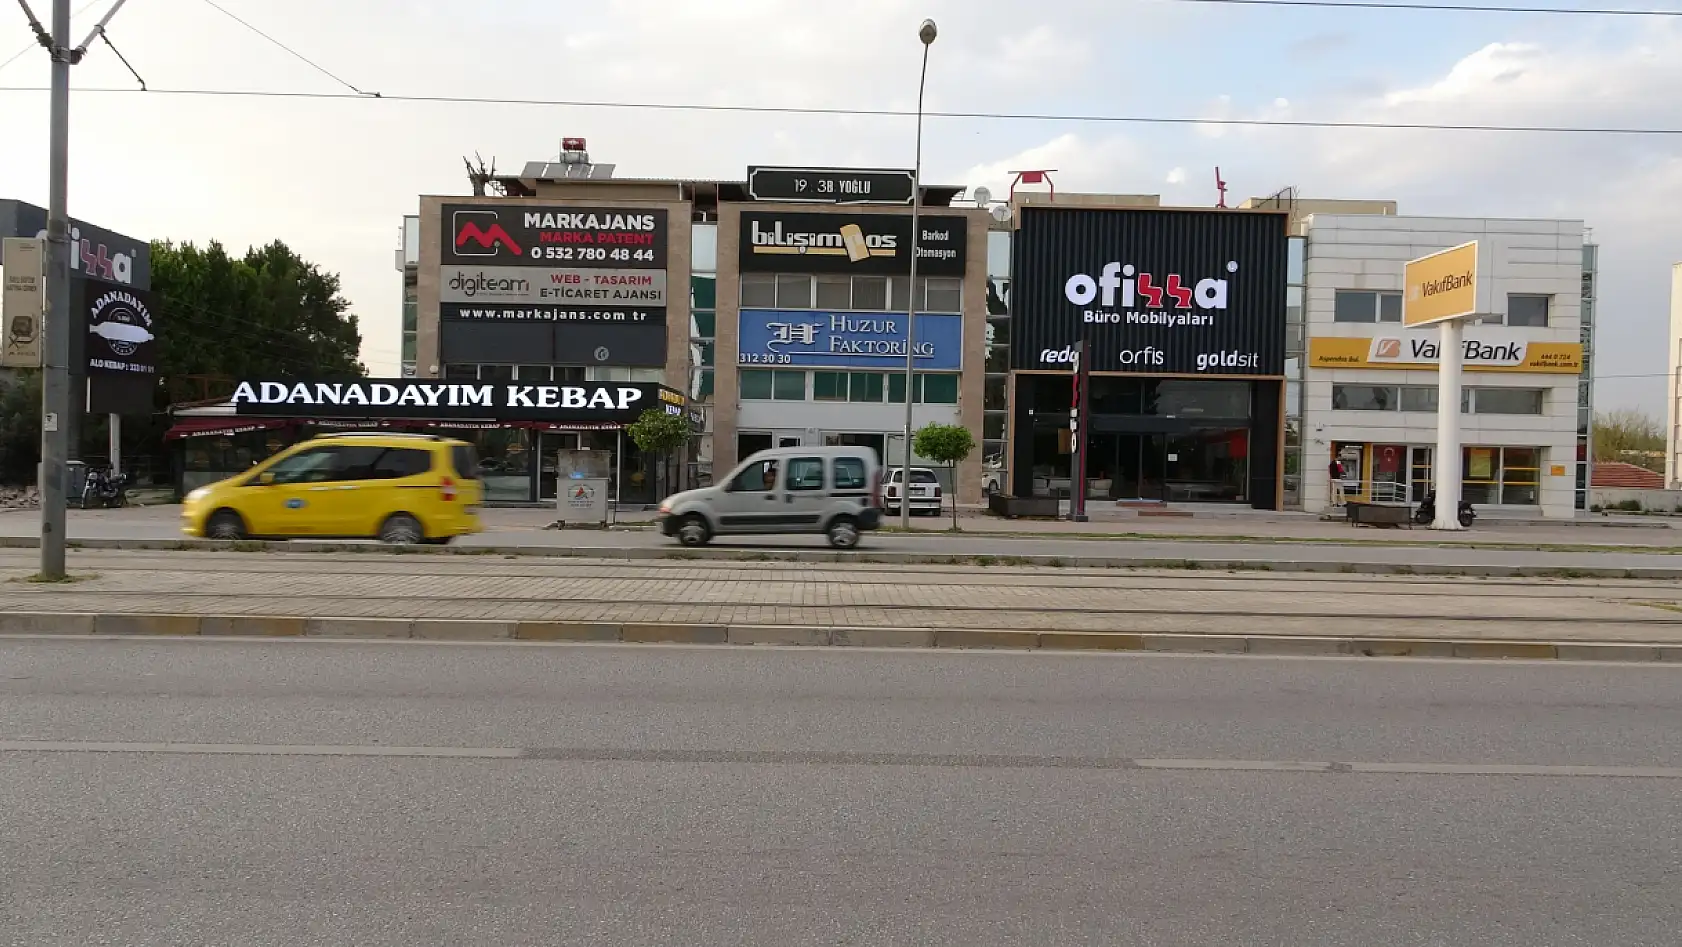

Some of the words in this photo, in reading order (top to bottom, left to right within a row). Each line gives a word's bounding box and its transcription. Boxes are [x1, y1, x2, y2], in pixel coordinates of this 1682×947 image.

[524, 211, 655, 231] MARKAJANS
[540, 232, 594, 244] MARKA
[597, 232, 655, 246] PATENT
[922, 229, 950, 241] Barkod
[531, 246, 543, 259] 0
[545, 246, 573, 260] 532
[577, 247, 606, 260] 780
[609, 248, 630, 261] 48
[633, 248, 654, 262] 44
[448, 271, 530, 298] digiteam
[550, 273, 581, 285] WEB
[593, 274, 653, 286] TASARIM
[539, 286, 609, 299] E-TİCARET
[612, 288, 662, 300] AJANSI
[459, 308, 626, 321] www.markajans.com
[632, 310, 647, 321] tr
[1083, 310, 1121, 323] Büro
[1126, 311, 1214, 328] Mobilyaları
[829, 314, 898, 335] HUZUR
[739, 352, 760, 364] 312
[761, 353, 775, 364] 30
[777, 354, 791, 364] 30
[1119, 346, 1164, 365] orfis
[1196, 349, 1259, 371] goldsit
[230, 381, 494, 407] ADANADAYIM
[506, 385, 643, 410] KEBAP
